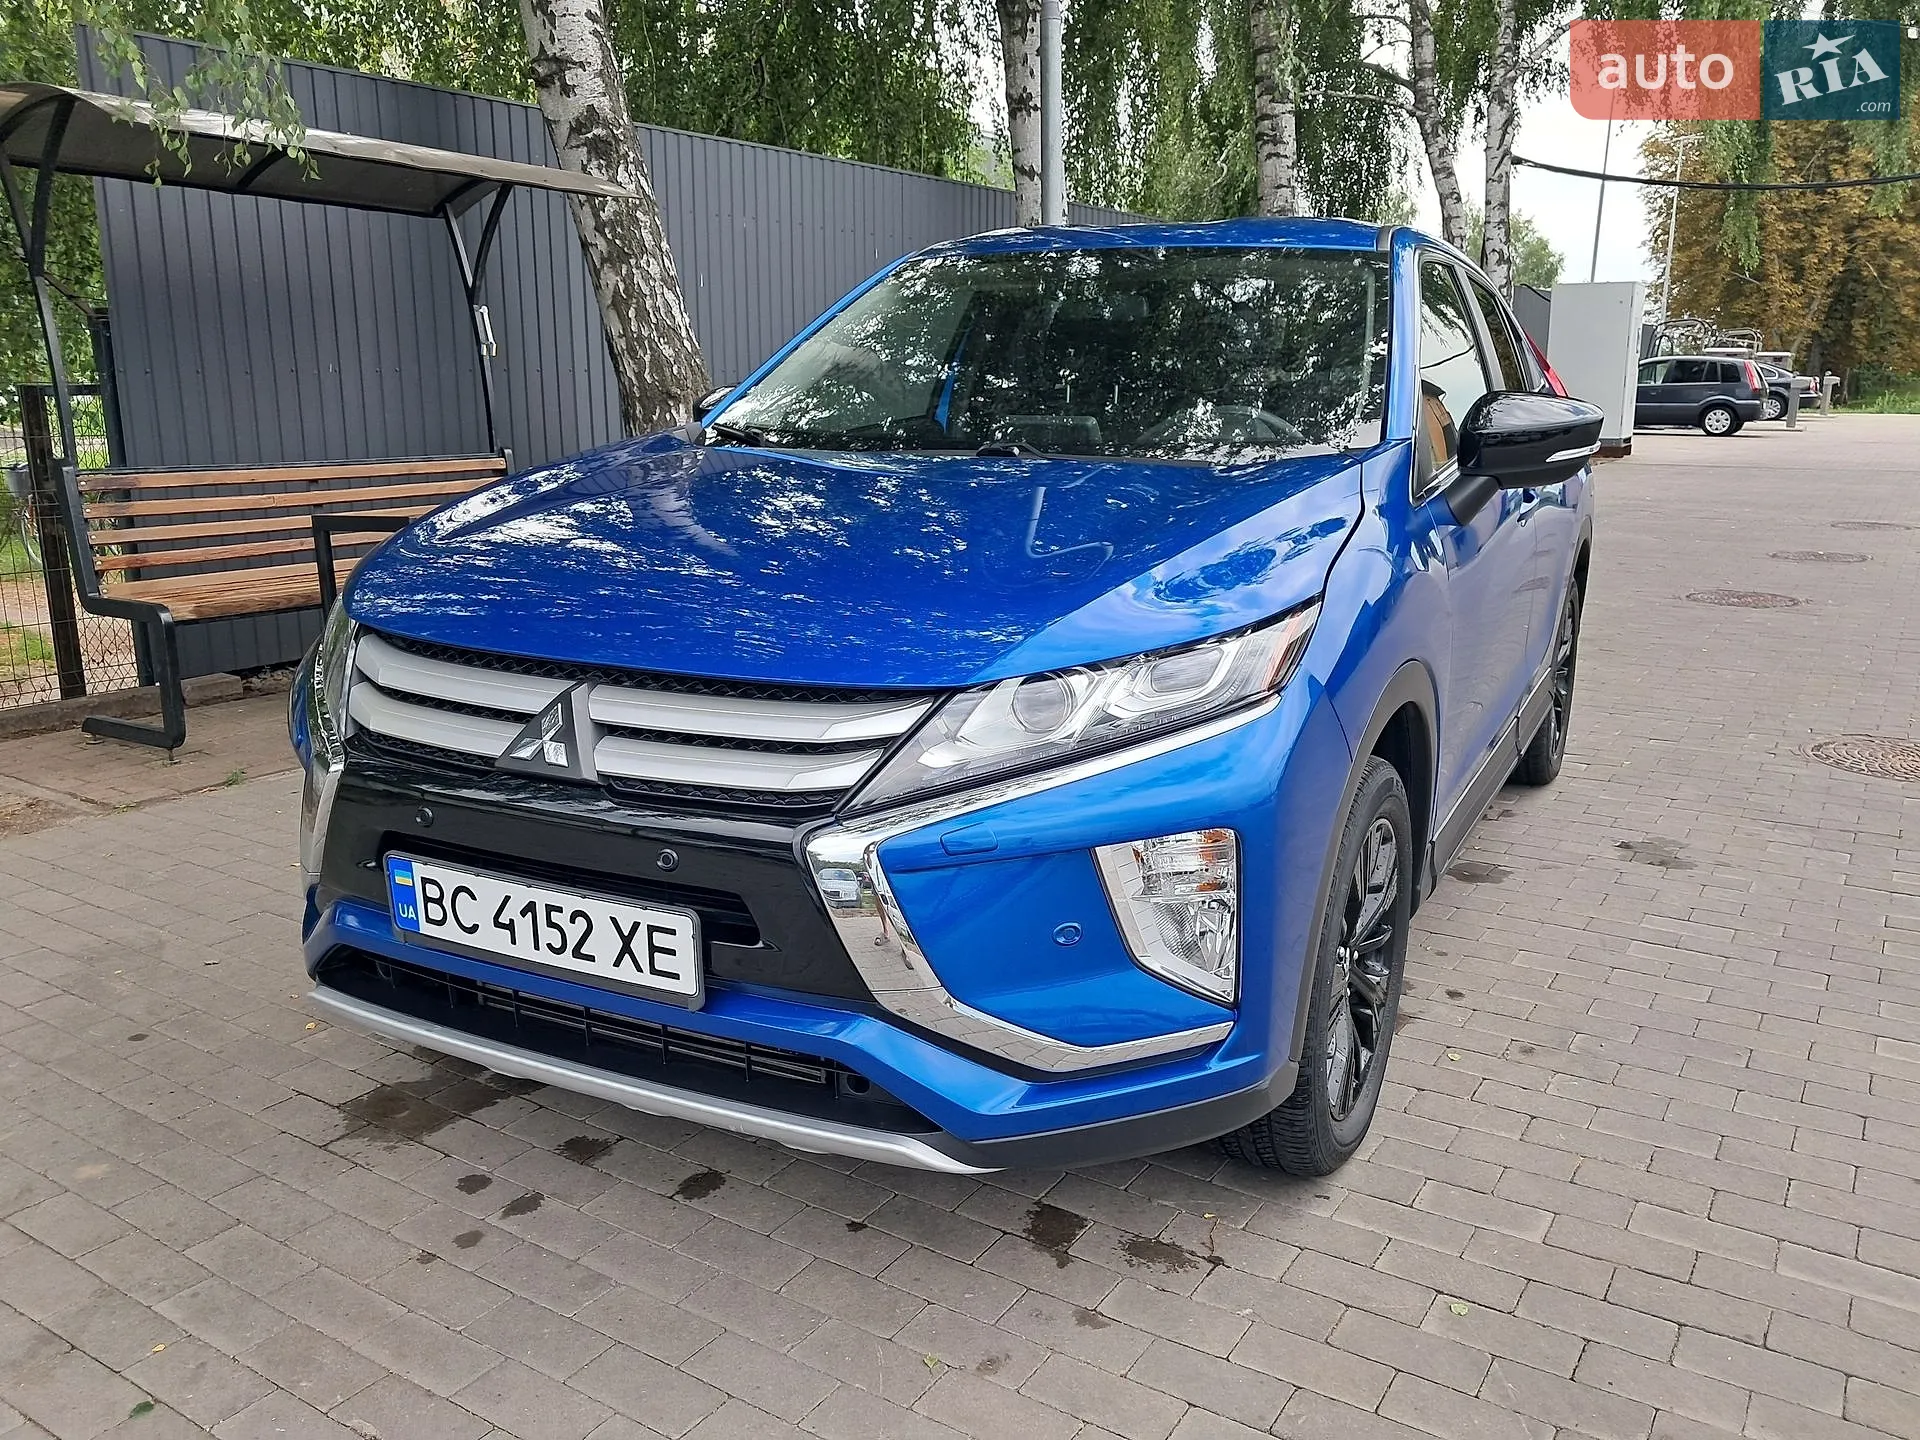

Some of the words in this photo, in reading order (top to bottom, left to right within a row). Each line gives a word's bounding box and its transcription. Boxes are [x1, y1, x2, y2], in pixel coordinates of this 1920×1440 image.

[399, 904, 416, 921] UA
[421, 876, 479, 934] BC
[492, 895, 596, 962] 4152
[609, 916, 681, 980] XE
